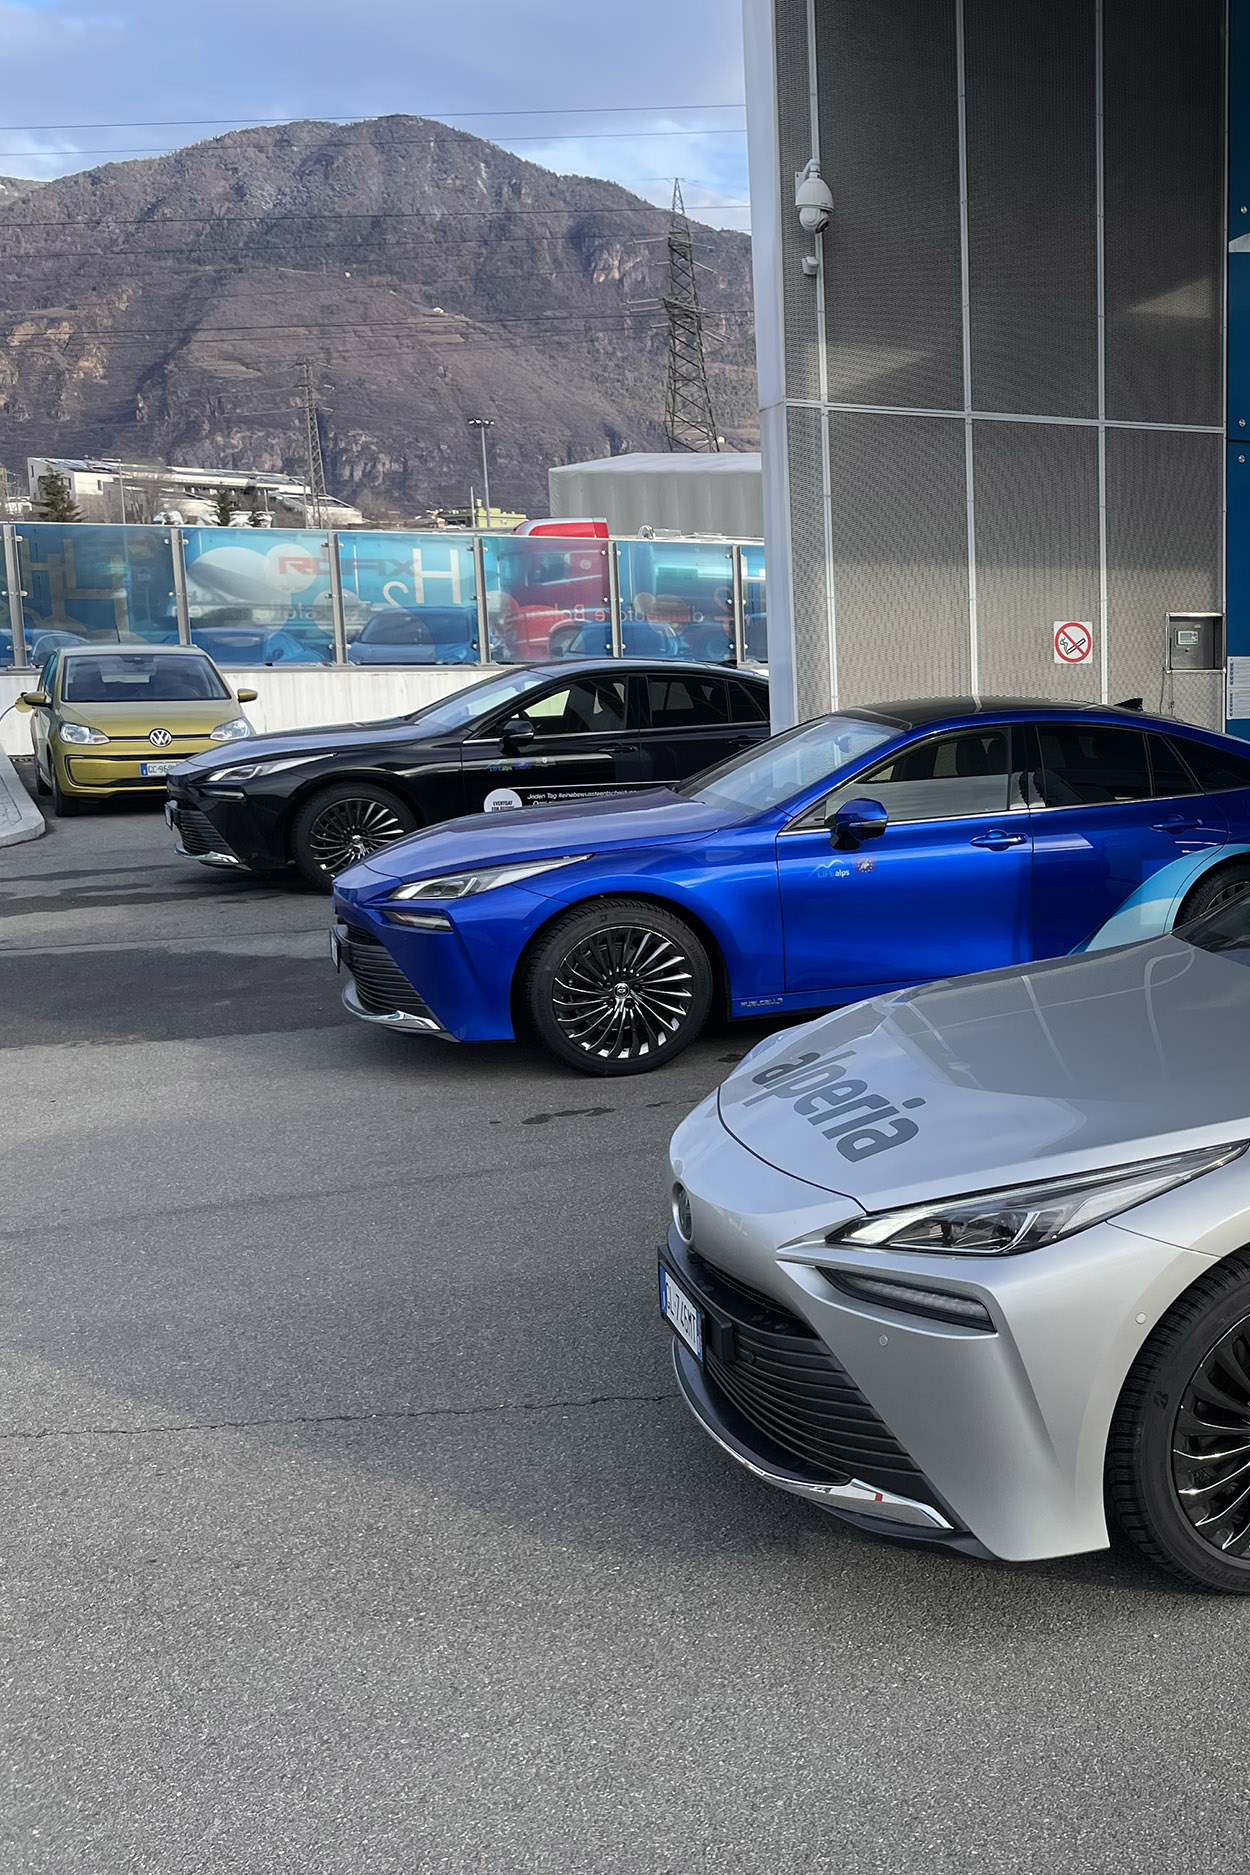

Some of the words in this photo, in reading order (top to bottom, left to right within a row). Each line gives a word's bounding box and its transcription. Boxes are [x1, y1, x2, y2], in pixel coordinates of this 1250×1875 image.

[547, 792, 557, 800] Tag
[817, 868, 850, 878] LIFEalps
[742, 1050, 927, 1163] alperia
